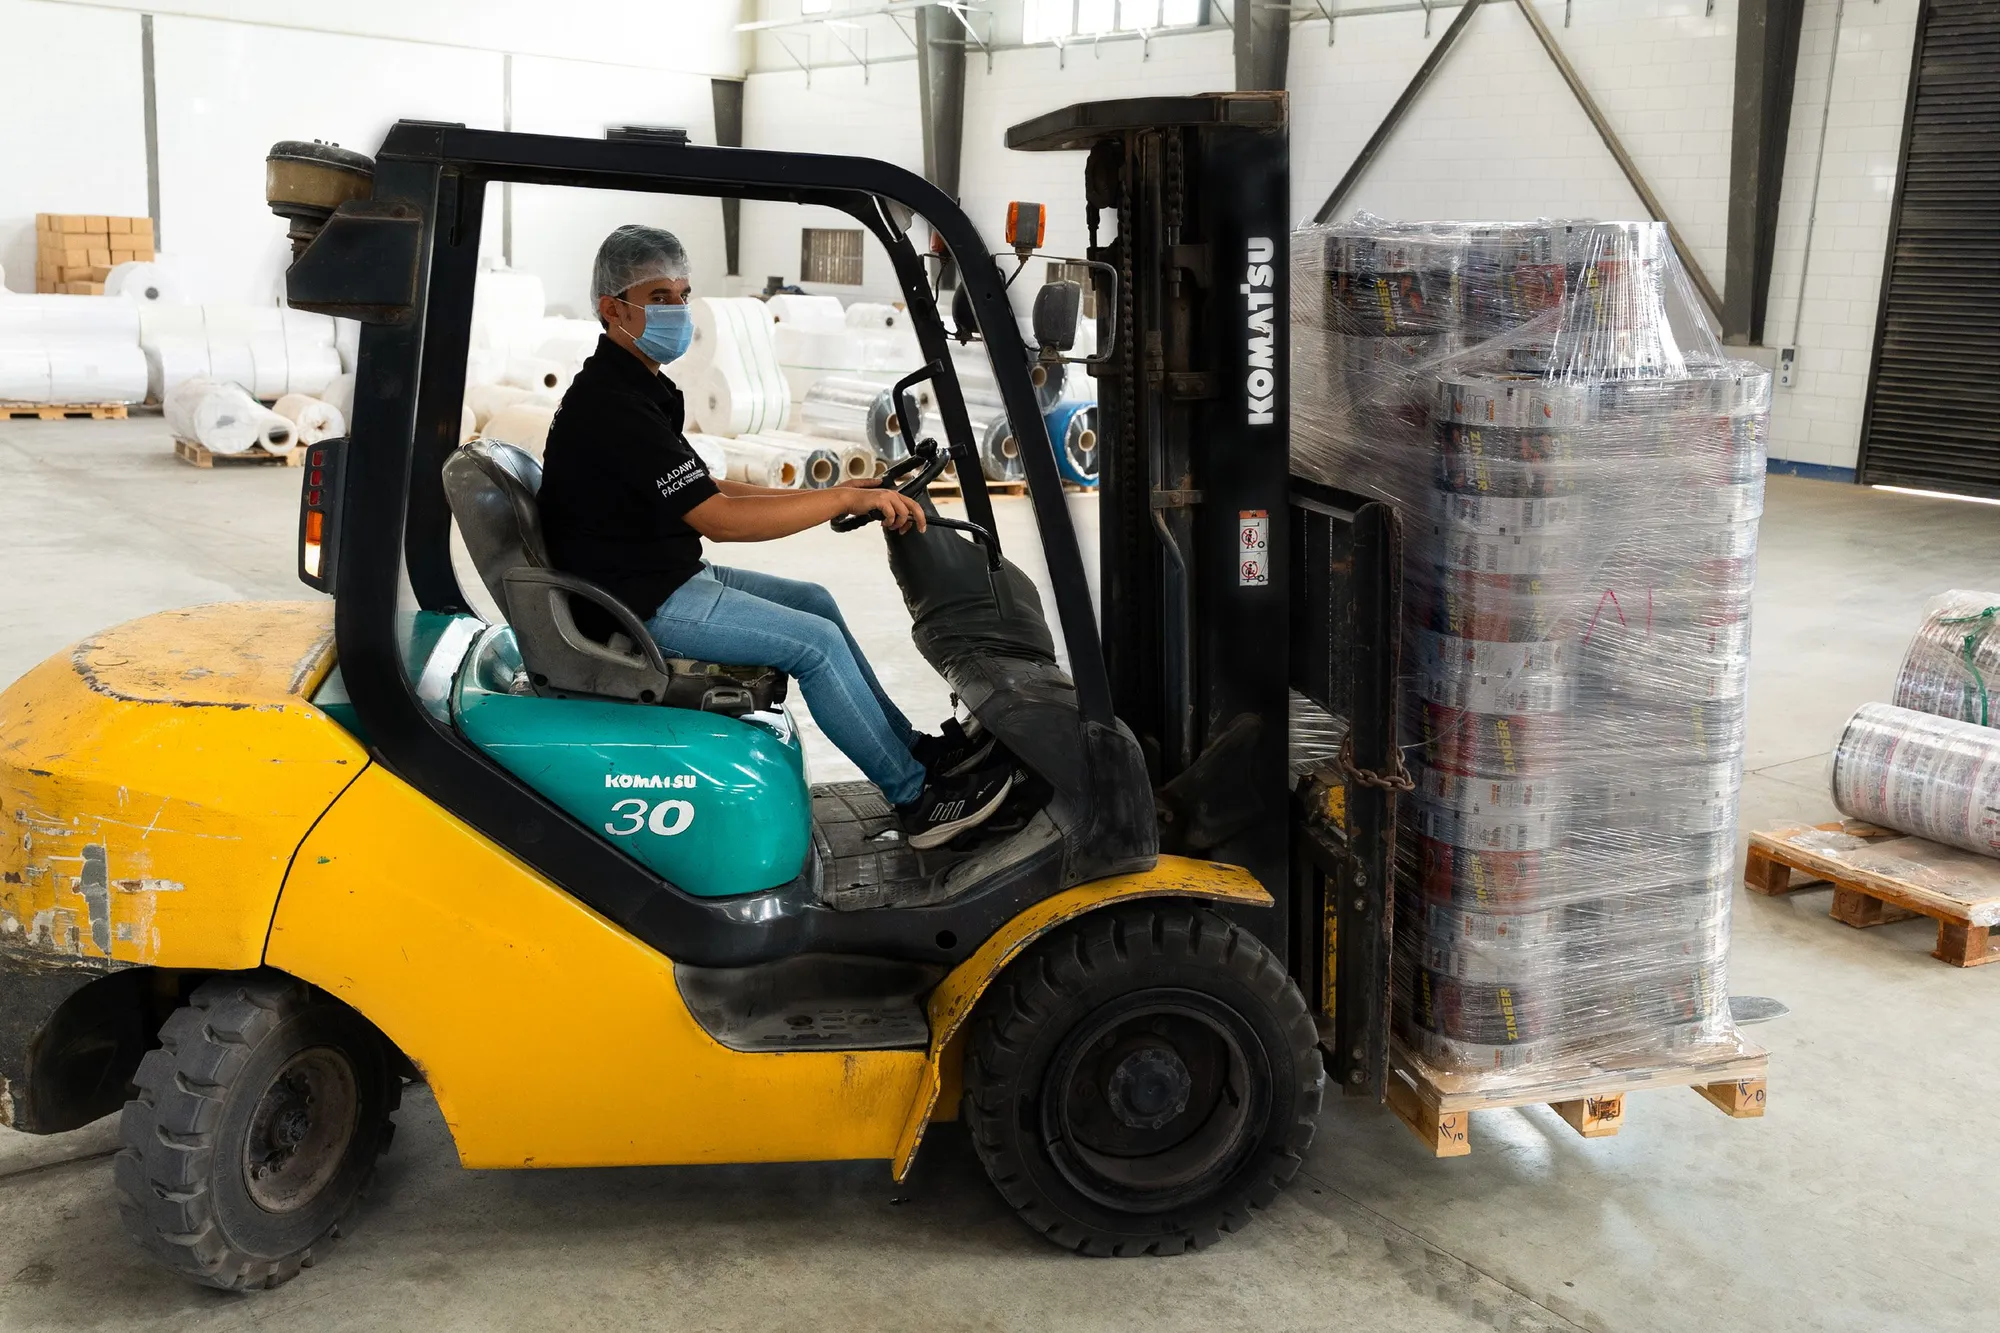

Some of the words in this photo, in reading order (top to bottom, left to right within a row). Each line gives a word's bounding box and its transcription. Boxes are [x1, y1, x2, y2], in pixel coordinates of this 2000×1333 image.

[1240, 237, 1274, 425] KOMATSU
[656, 458, 697, 489] ALADAWY
[661, 478, 687, 498] PACK
[1496, 719, 1518, 774] ZINGER
[604, 798, 695, 836] 30
[1422, 971, 1435, 1028] ZINGER
[1499, 987, 1519, 1041] ZINGER
